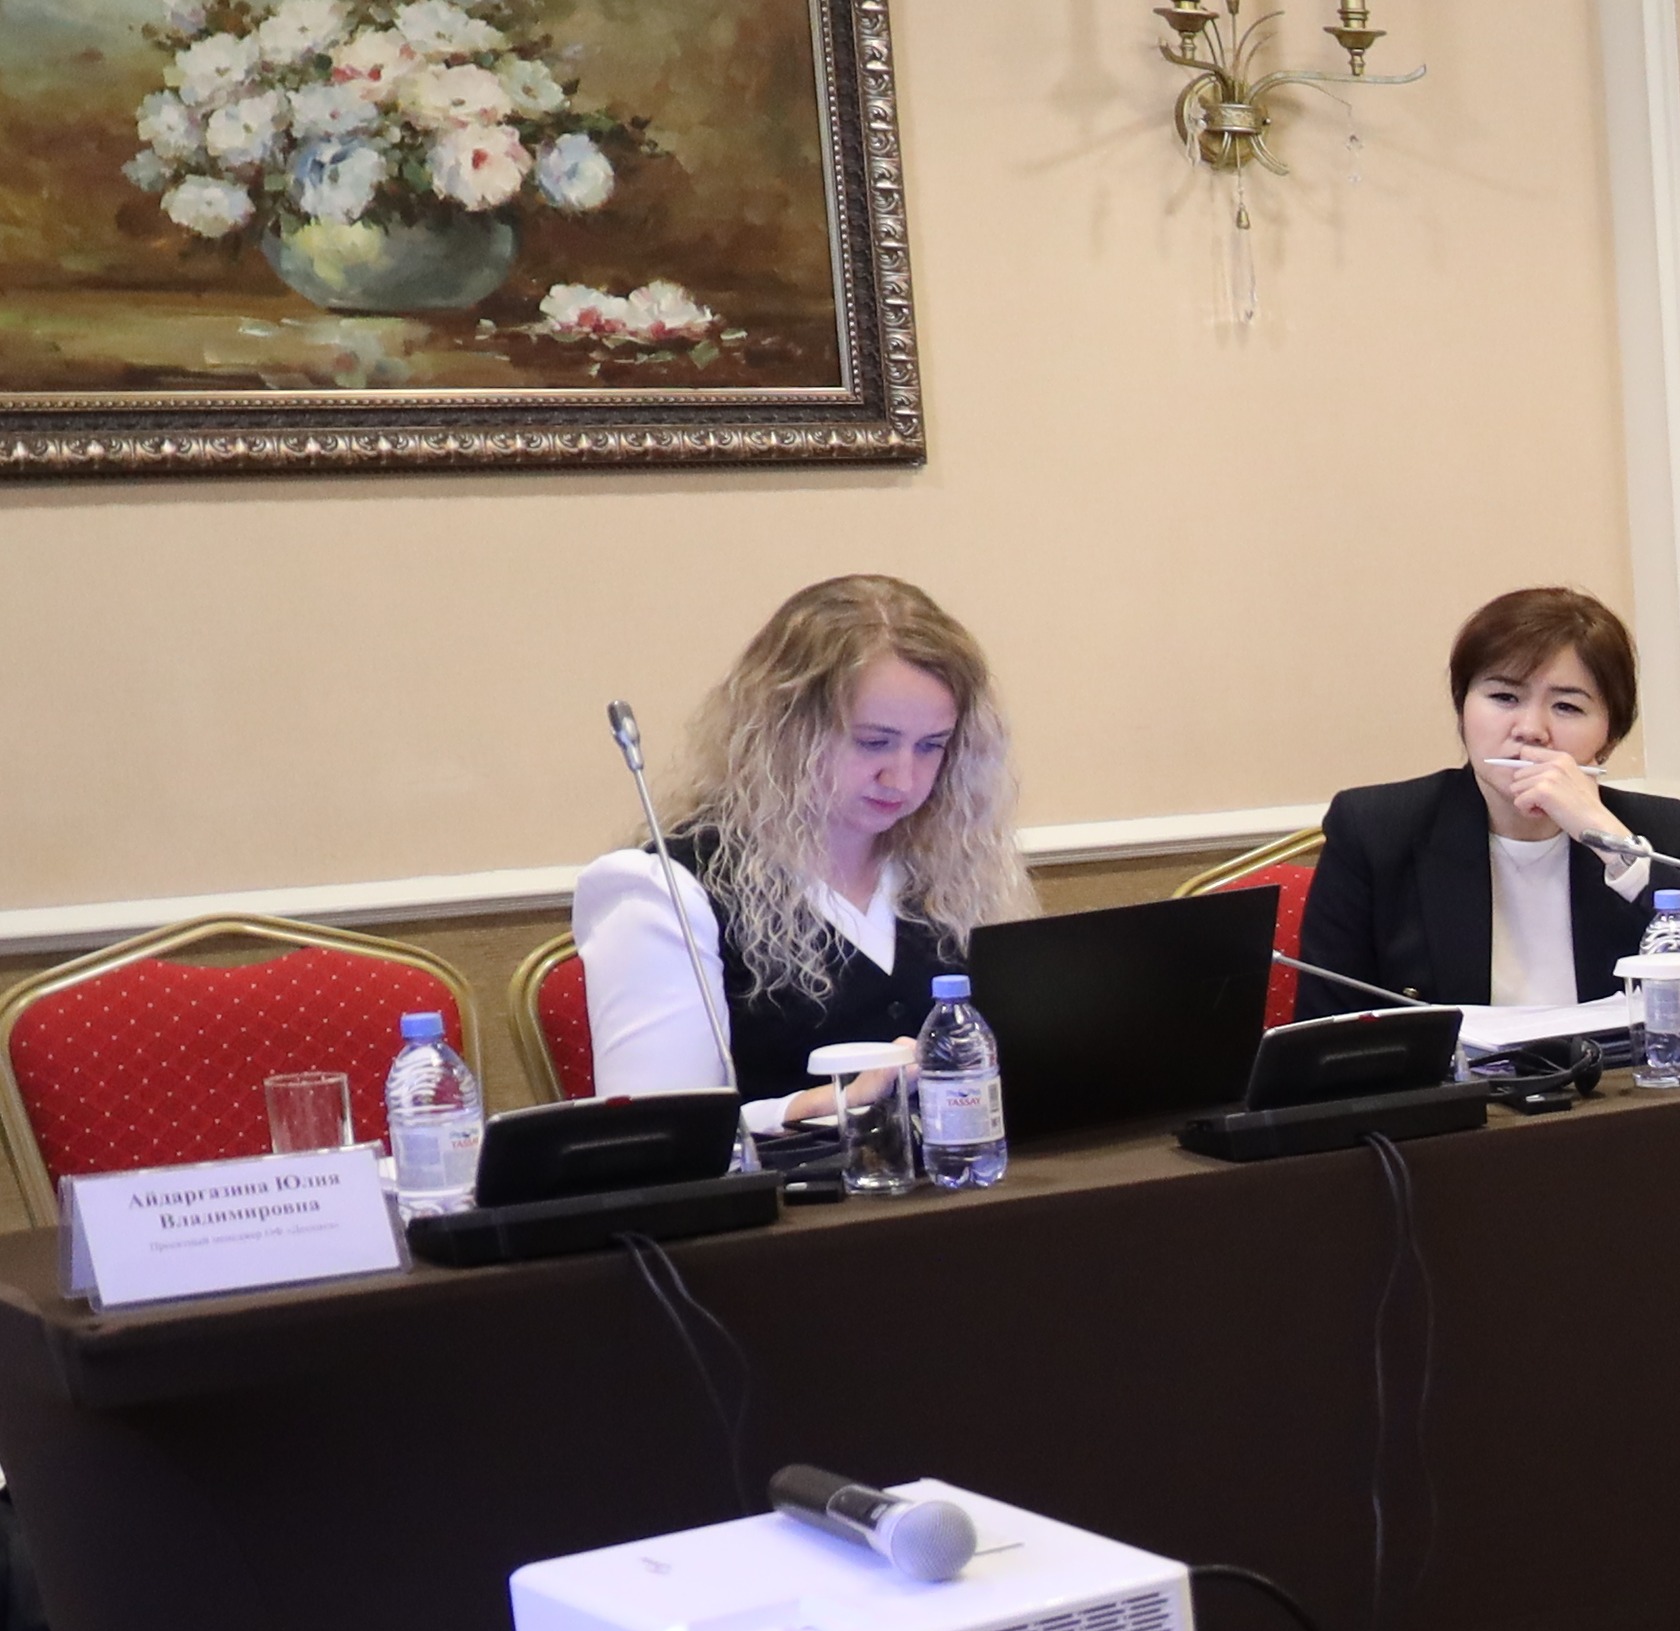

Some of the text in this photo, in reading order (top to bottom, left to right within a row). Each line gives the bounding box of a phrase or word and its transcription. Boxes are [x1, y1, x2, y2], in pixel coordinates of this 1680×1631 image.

[128, 1171, 341, 1210] Айдаргазина Юлия
[159, 1199, 321, 1231] Владимировна
